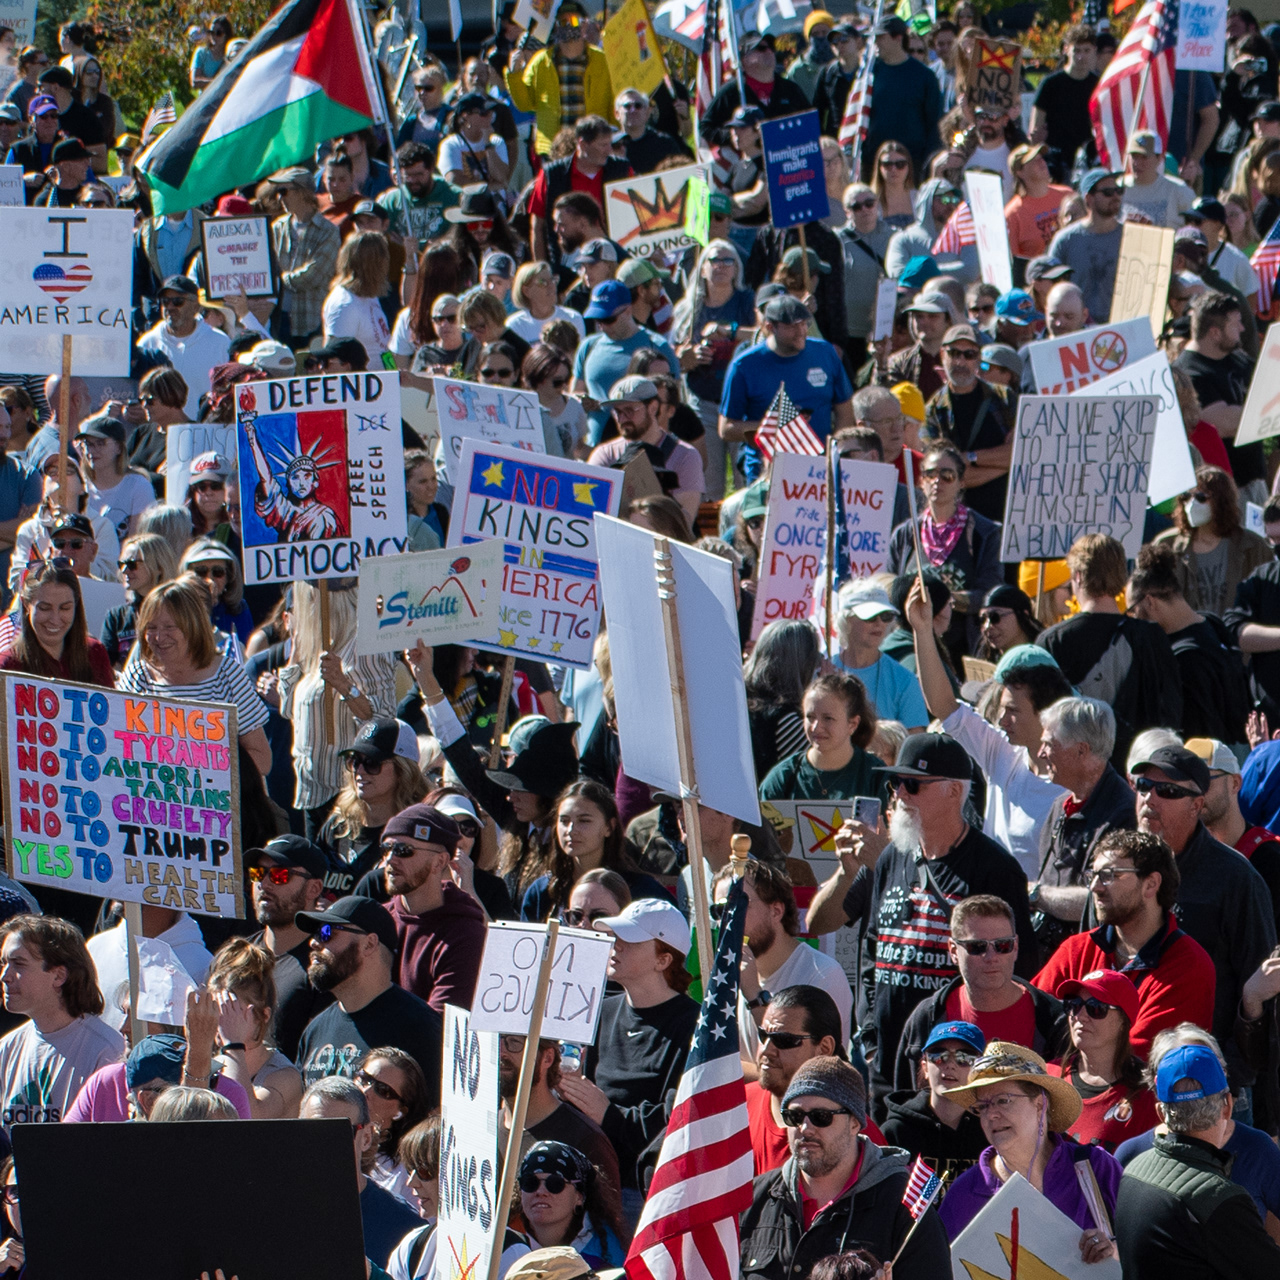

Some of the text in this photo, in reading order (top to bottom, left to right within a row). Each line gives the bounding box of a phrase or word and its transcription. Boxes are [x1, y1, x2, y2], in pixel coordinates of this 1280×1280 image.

[43, 216, 88, 258] I
[0, 305, 129, 329] AMERICA
[268, 373, 384, 412] DEFEND
[349, 458, 365, 508] FREE
[371, 446, 388, 521] SPEECH
[512, 467, 561, 511] NO
[477, 499, 591, 548] KINGS
[519, 544, 545, 569] IN
[377, 590, 459, 631] Stemilt
[541, 610, 591, 640] 1776
[14, 683, 225, 741] NO TO KINGS
[16, 719, 230, 771] NO TO TYRANTS
[16, 745, 60, 777] NO
[60, 749, 101, 782] TO
[19, 778, 231, 838] NO TO CRUELTY
[126, 778, 230, 811] TARIANS
[20, 807, 230, 866] NO TO TRUMP
[13, 838, 234, 895] YES TO HEALTH
[142, 886, 221, 913] CARE
